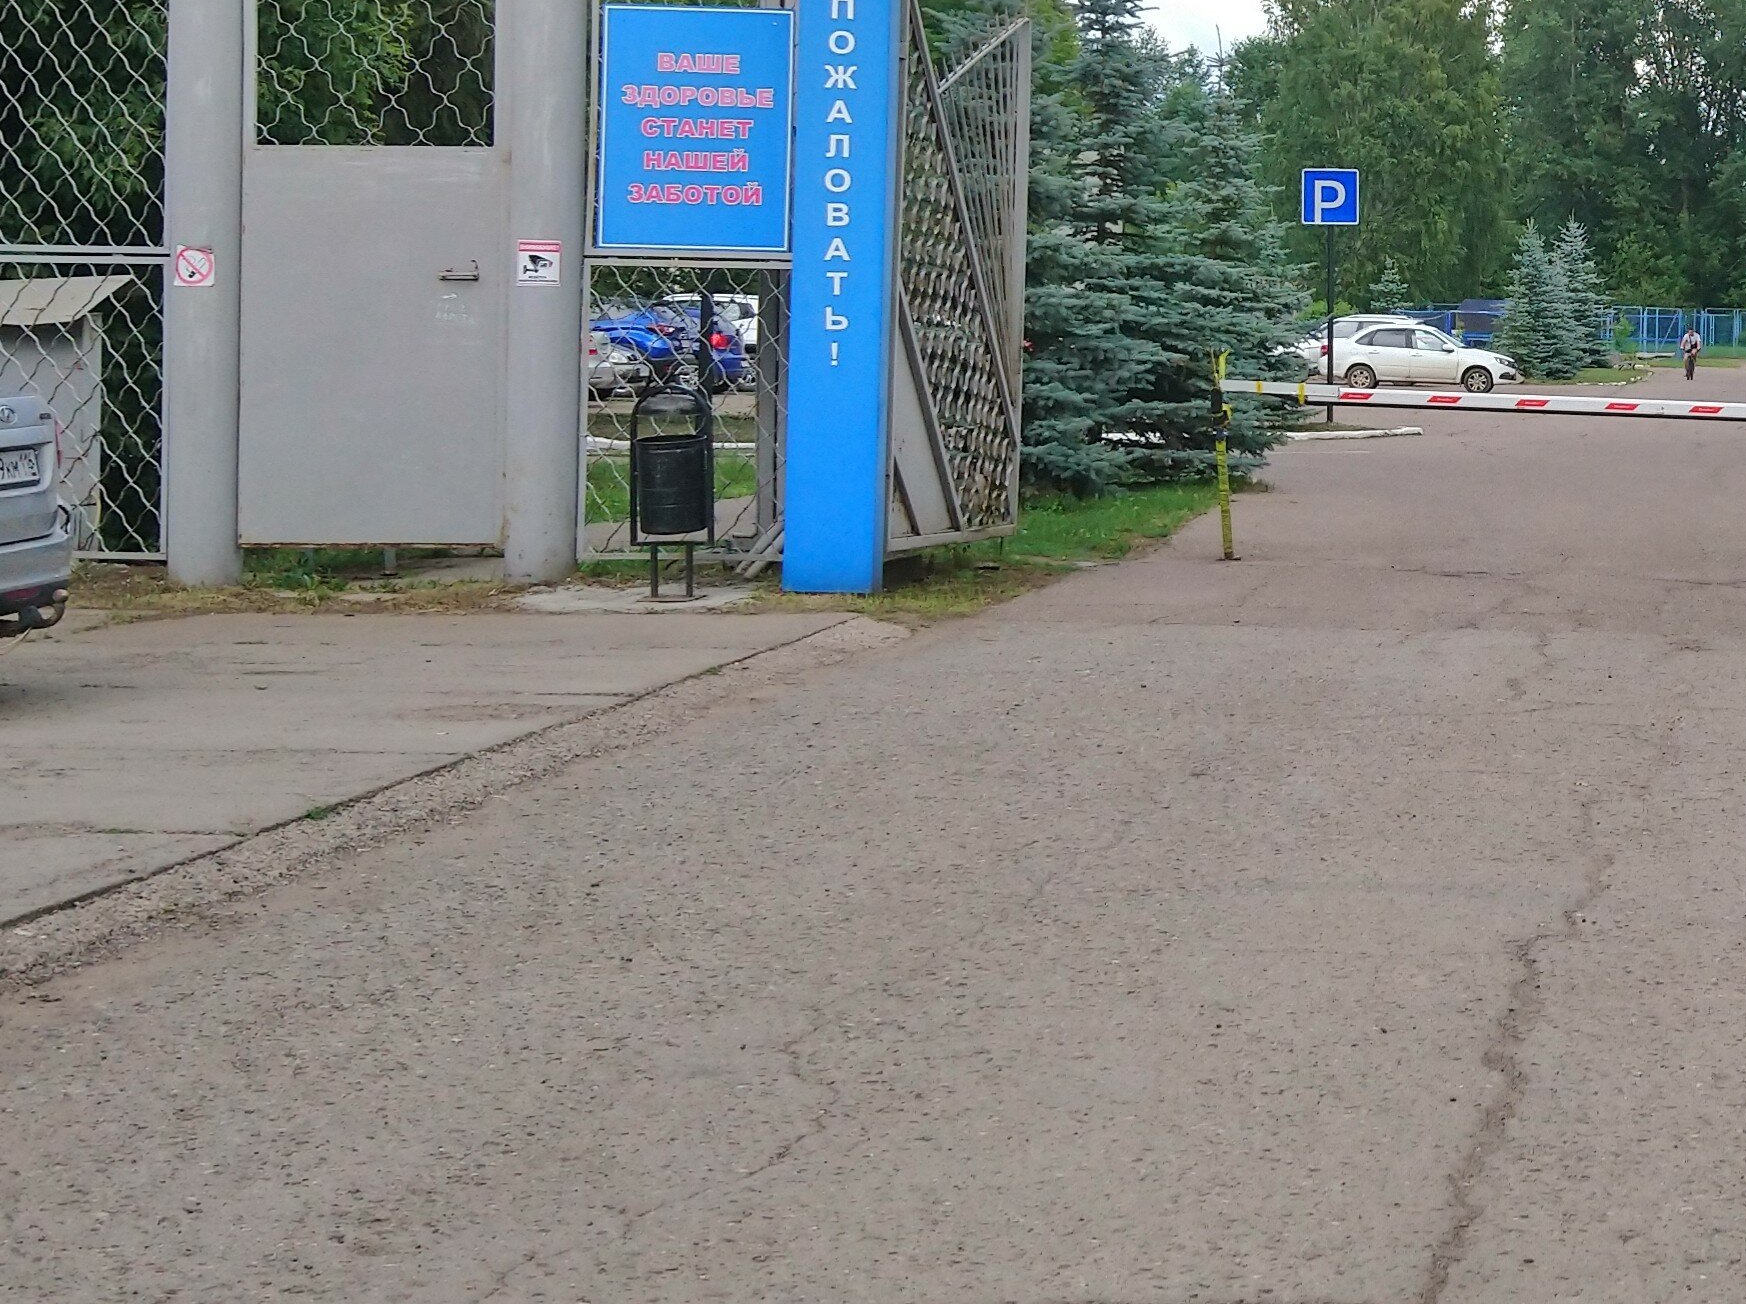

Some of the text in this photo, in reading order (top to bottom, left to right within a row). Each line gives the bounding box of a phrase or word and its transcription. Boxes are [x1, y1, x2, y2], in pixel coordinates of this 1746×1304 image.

[657, 52, 741, 74] ВАШЕ
[621, 84, 774, 108] ЗДОРОВЬЕ
[641, 117, 753, 139] СТАНЕТ
[643, 149, 748, 172] НАШЕЙ
[627, 182, 763, 206] ЗАБОТОЙ
[1314, 180, 1346, 223] P
